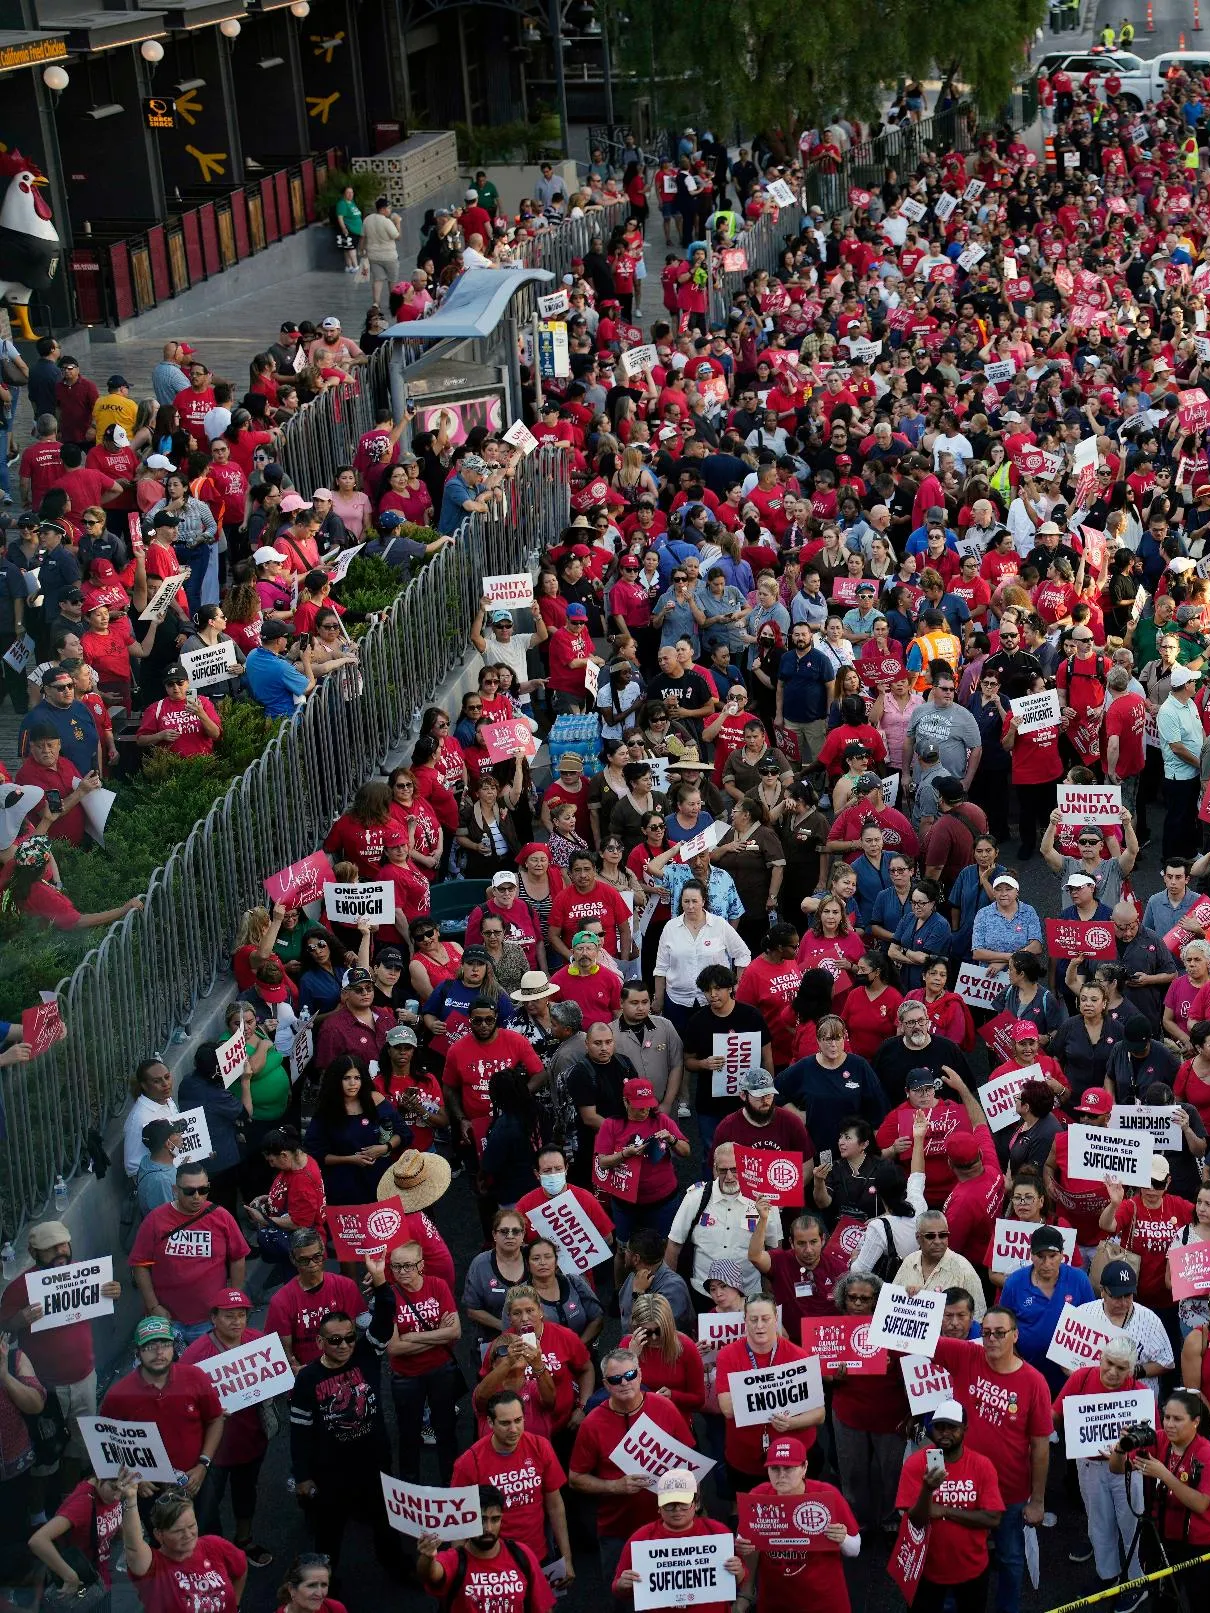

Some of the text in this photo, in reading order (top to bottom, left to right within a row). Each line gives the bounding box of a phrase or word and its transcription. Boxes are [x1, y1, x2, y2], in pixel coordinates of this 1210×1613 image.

[1, 41, 66, 66] California Fried Chicken
[486, 589, 532, 601] UNIDAD
[489, 580, 527, 592] UNITY
[192, 661, 229, 681] SUFICIENTE
[1022, 707, 1054, 724] SUFICIENTE
[1065, 792, 1114, 803] UNITY
[1060, 803, 1120, 815] UNIDAD
[280, 859, 320, 894] Unity
[335, 886, 384, 895] ONE JOB
[335, 898, 383, 916] ENOUGH
[571, 901, 604, 912] VEGAS
[770, 980, 801, 993] STRON
[959, 973, 1006, 991] NIDAD
[961, 985, 996, 1001] NITY
[224, 1036, 246, 1060] UNI
[222, 1050, 247, 1075] UNI
[725, 1035, 738, 1095] UNIDAD
[739, 1041, 752, 1076] UNI
[986, 1097, 1017, 1118] UNI
[1119, 1115, 1171, 1130] SUFICIENTE
[1086, 1132, 1141, 1148] UN EMPLEO
[1083, 1152, 1138, 1174] SUFICIENTE
[557, 1203, 599, 1256] UNITY
[1133, 1228, 1178, 1239] STRONG
[1137, 1219, 1173, 1230] VEGAS
[170, 1230, 211, 1244] UNITE
[541, 1204, 589, 1271] UNIDAD
[166, 1240, 212, 1258] HERE!
[41, 1265, 101, 1287] ONE JOB
[44, 1283, 101, 1317] ENOUGH
[906, 1297, 935, 1310] EMPLEO
[710, 1323, 747, 1338] UNI
[882, 1315, 930, 1340] SUFICIENTE
[1064, 1317, 1112, 1345] UNITY
[1054, 1329, 1103, 1362] UNIDA
[210, 1347, 273, 1384] UNITY
[213, 1360, 288, 1399] UNIDAD
[744, 1365, 808, 1387] ONE JOB
[910, 1375, 953, 1397] UNI
[747, 1381, 809, 1413] ENOUGH
[968, 1384, 1011, 1411] STRON
[1078, 1399, 1138, 1414] UN EMPLEO
[94, 1423, 147, 1439] ONE JOB
[1079, 1420, 1137, 1444] SUFICIEN
[623, 1437, 669, 1478] UNID
[638, 1431, 701, 1473] UNITY
[489, 1467, 536, 1487] VEGAS
[496, 1475, 543, 1496] TRONG
[939, 1480, 974, 1491] EGAS
[392, 1488, 466, 1514] UNITY
[936, 1491, 977, 1503] RONG
[388, 1500, 478, 1530] UNIDAD
[648, 1544, 718, 1560] UN EMPLEO
[694, 1557, 710, 1565] SER
[471, 1569, 519, 1586] VEGAS
[649, 1567, 717, 1593] SUFICIENTE
[465, 1581, 524, 1598] STRONG
